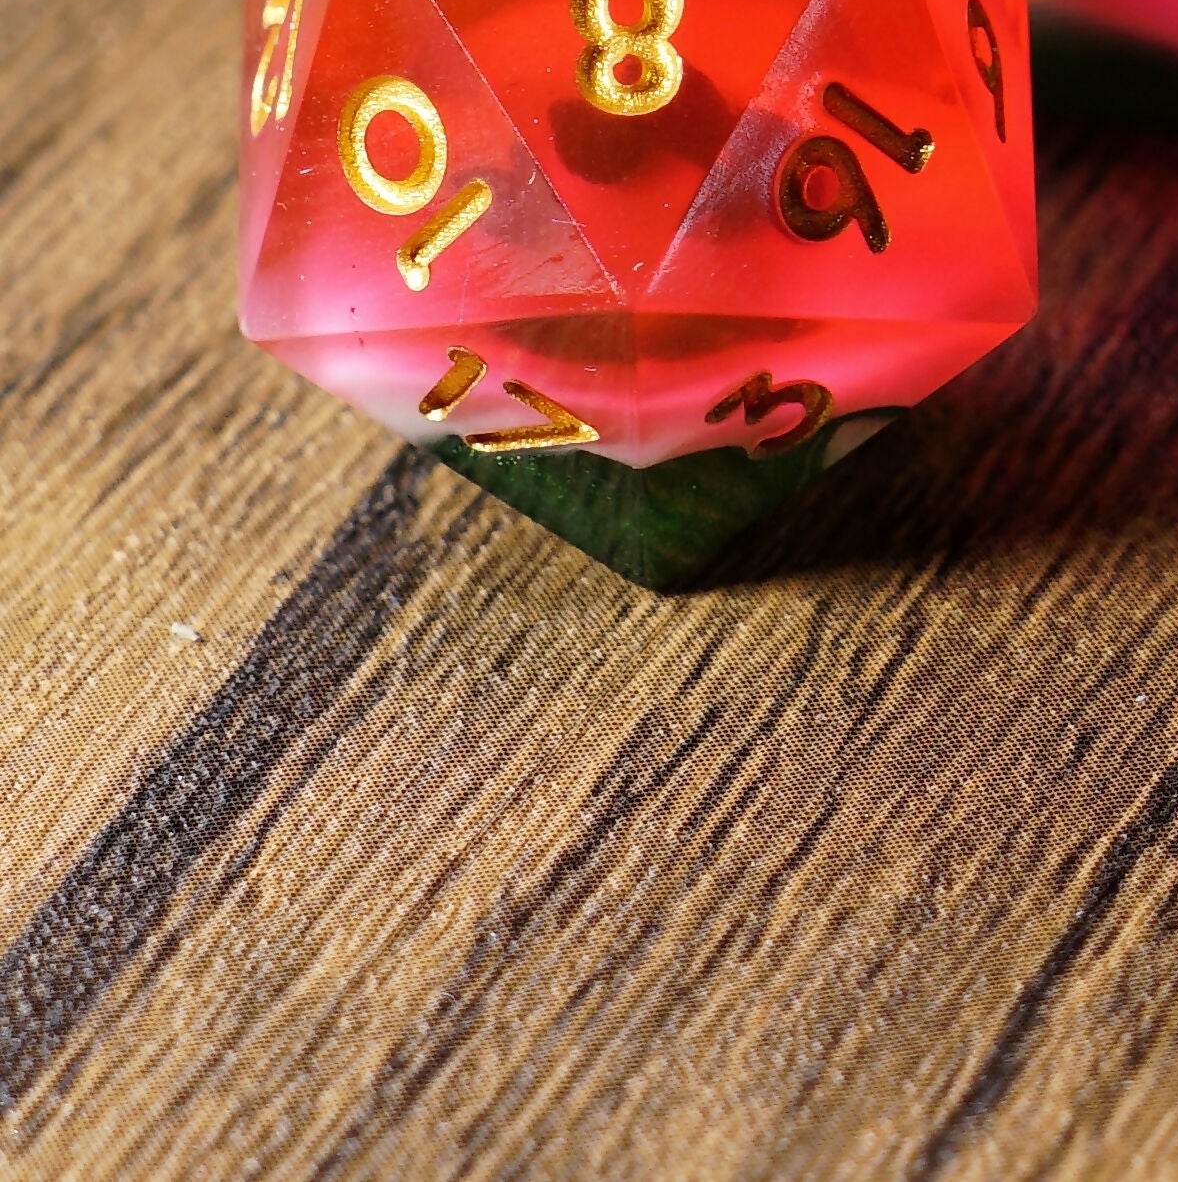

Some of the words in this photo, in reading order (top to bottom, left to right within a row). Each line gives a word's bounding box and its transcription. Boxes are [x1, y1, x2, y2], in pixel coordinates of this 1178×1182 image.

[337, 75, 494, 292] 10
[774, 81, 936, 255] 16
[418, 344, 600, 453] 17
[704, 370, 834, 461] 3
